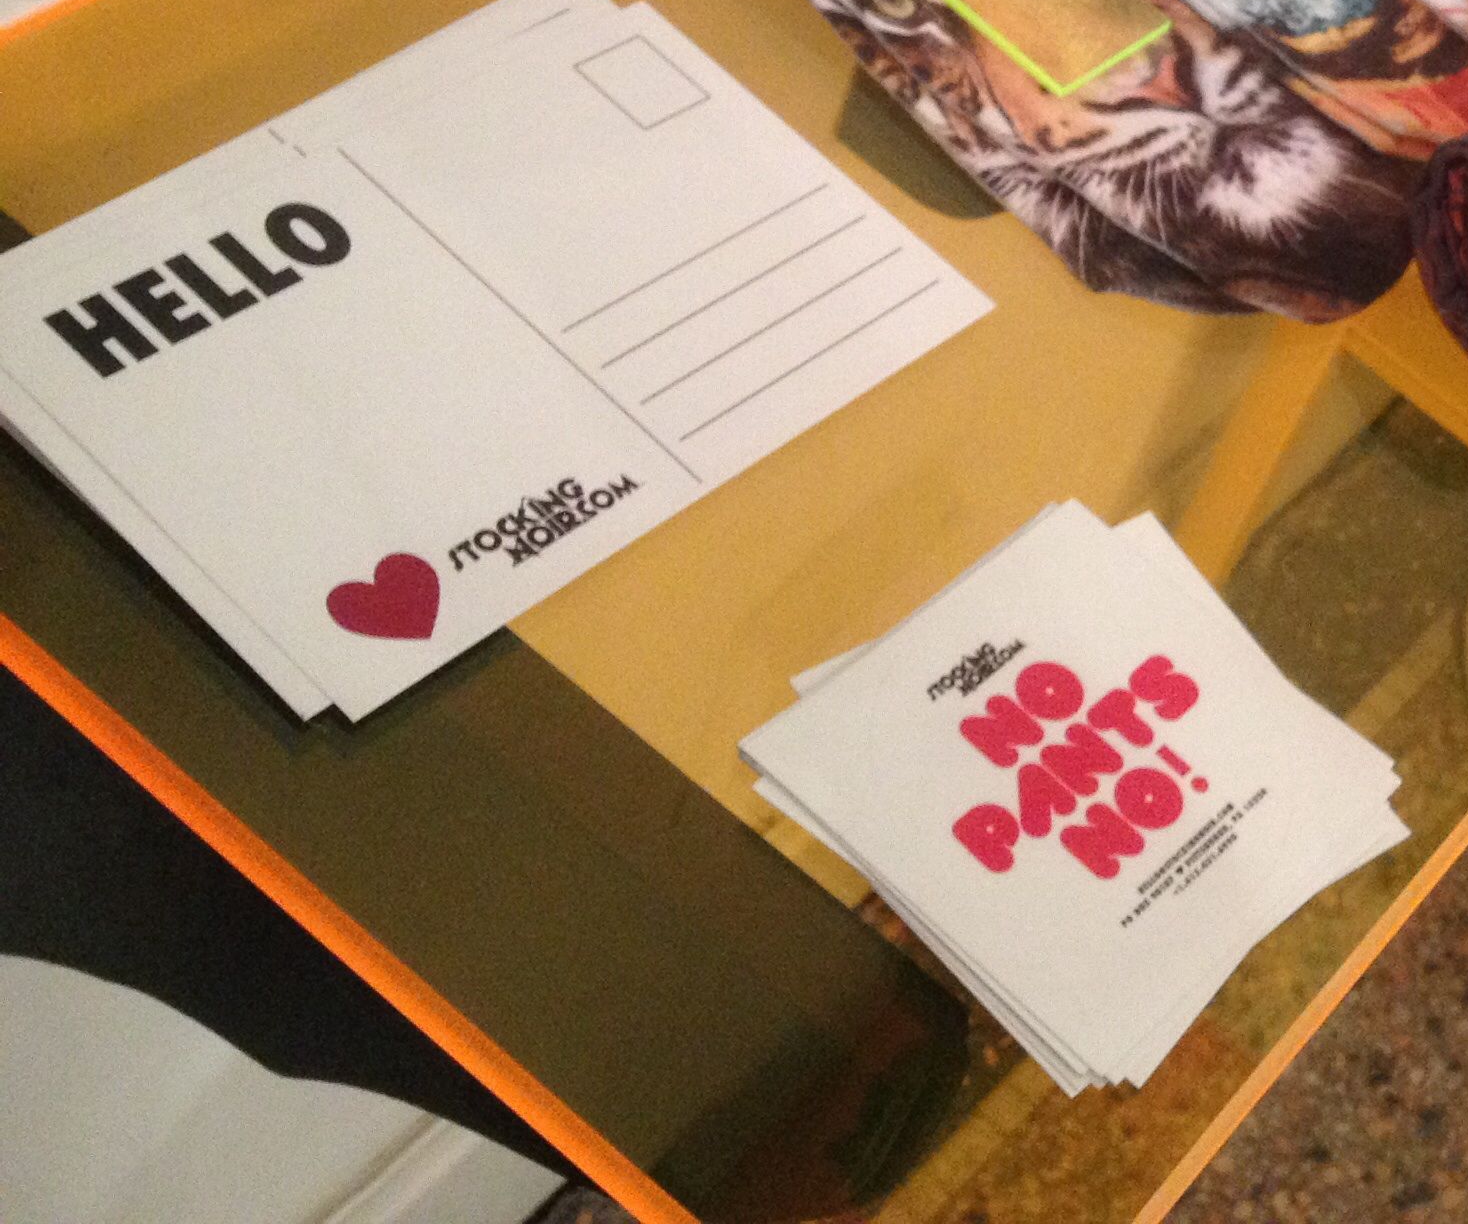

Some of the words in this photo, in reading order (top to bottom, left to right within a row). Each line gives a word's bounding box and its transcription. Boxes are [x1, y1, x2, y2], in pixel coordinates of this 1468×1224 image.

[44, 202, 351, 378] HELLO
[952, 655, 1199, 873] PANTS
[959, 661, 1084, 768] NO
[1060, 744, 1209, 879] NO!
